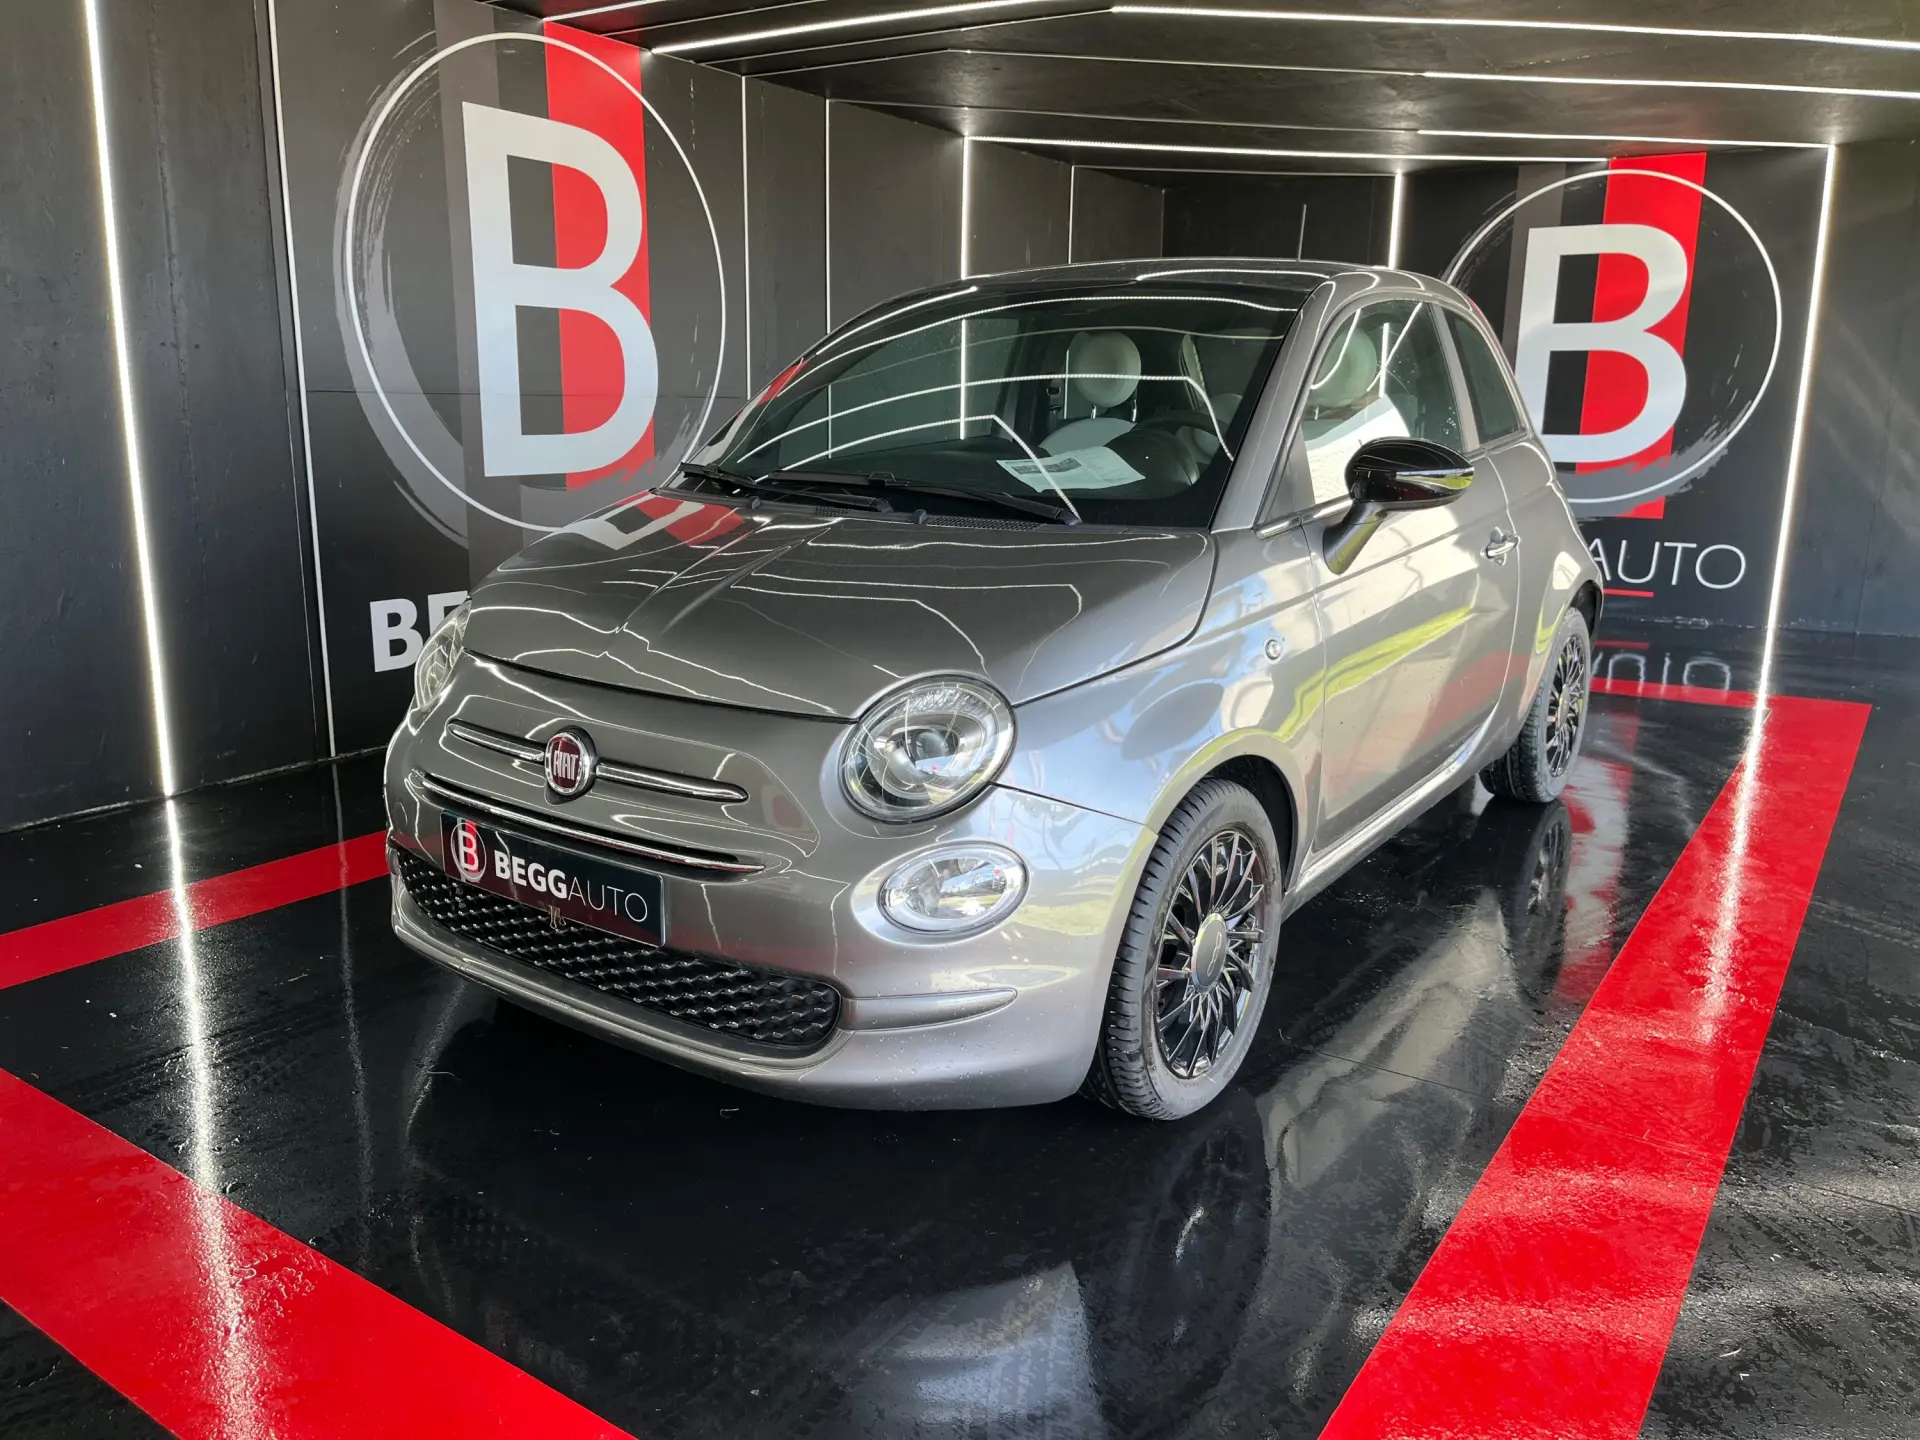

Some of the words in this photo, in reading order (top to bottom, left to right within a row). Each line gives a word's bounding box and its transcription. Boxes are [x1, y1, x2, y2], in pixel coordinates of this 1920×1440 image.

[462, 101, 659, 477] B
[1515, 223, 1689, 463] B
[553, 749, 579, 781] FIAT
[458, 829, 479, 871] B
